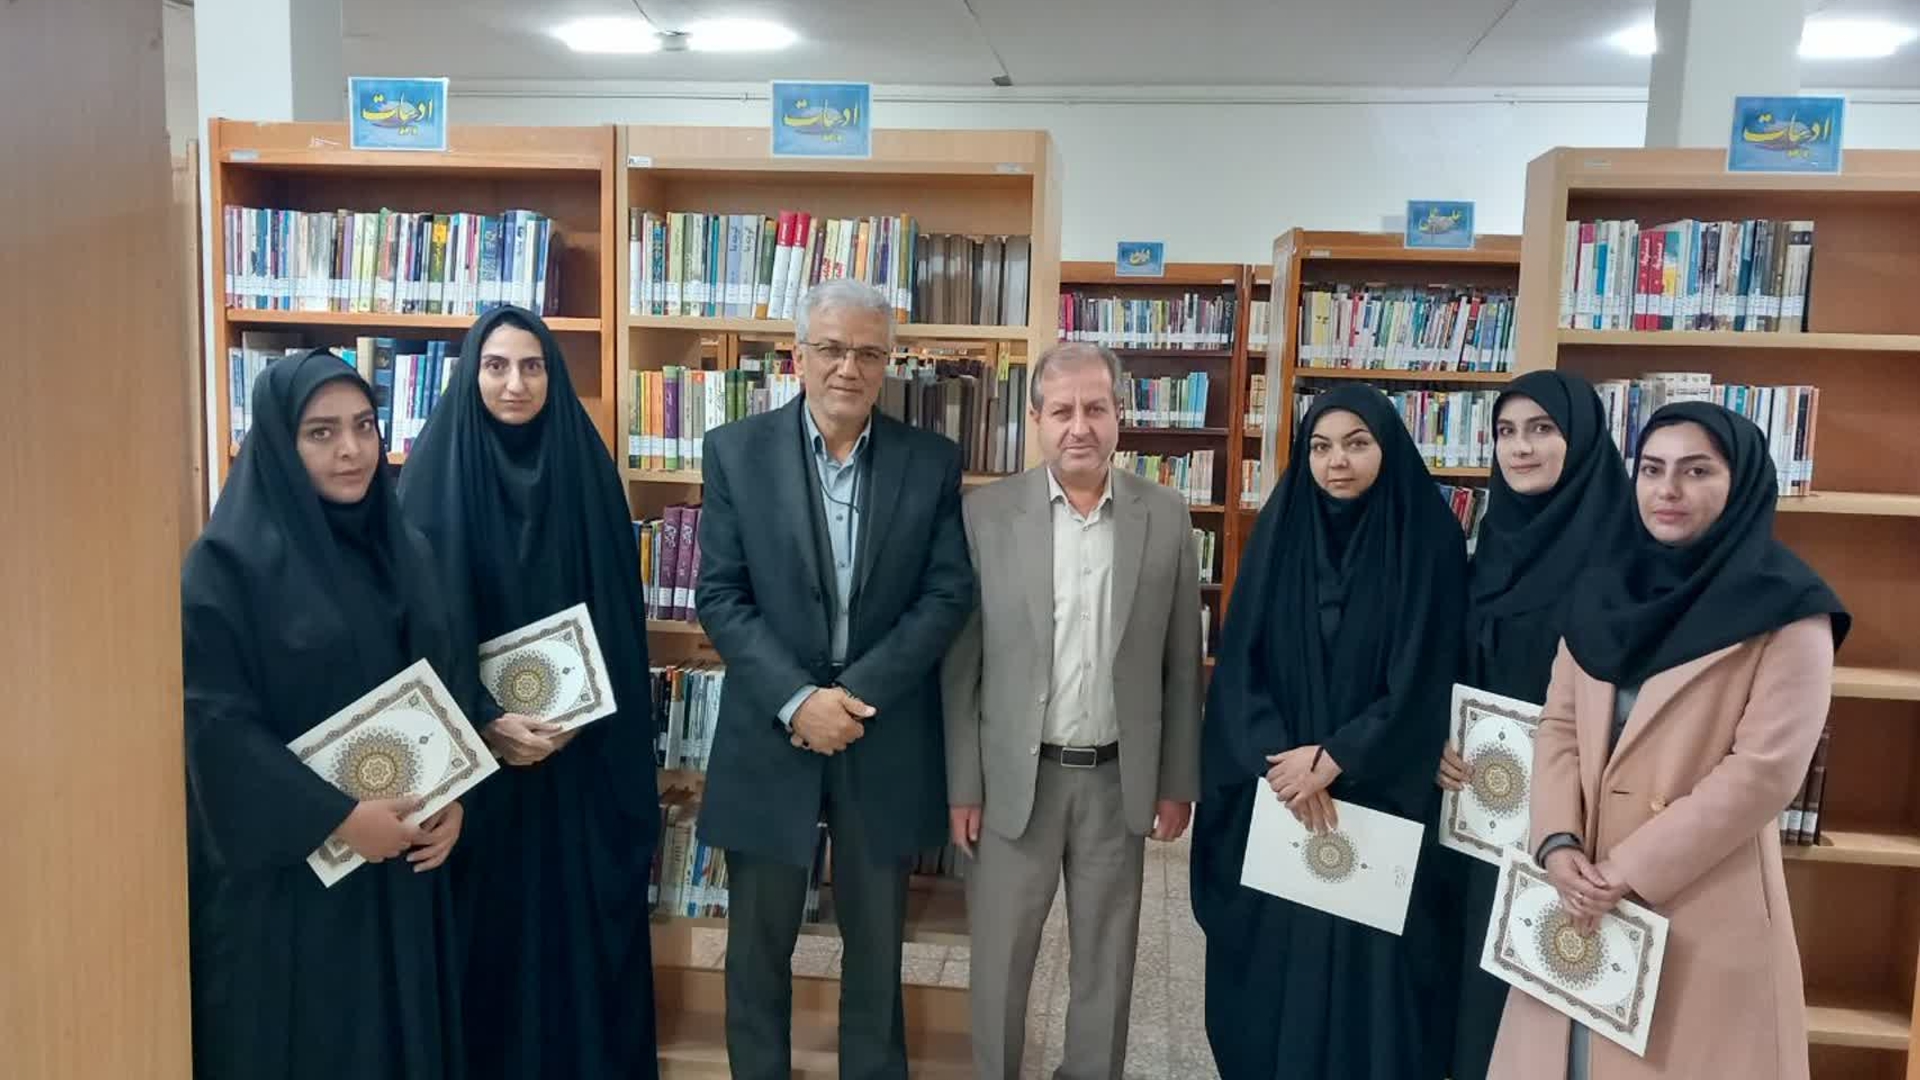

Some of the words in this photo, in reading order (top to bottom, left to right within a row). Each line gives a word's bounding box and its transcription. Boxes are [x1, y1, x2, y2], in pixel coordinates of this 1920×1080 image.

[362, 92, 433, 135] ادبیات
[782, 99, 860, 142] ادبیات
[1743, 110, 1830, 158] ادبیات
